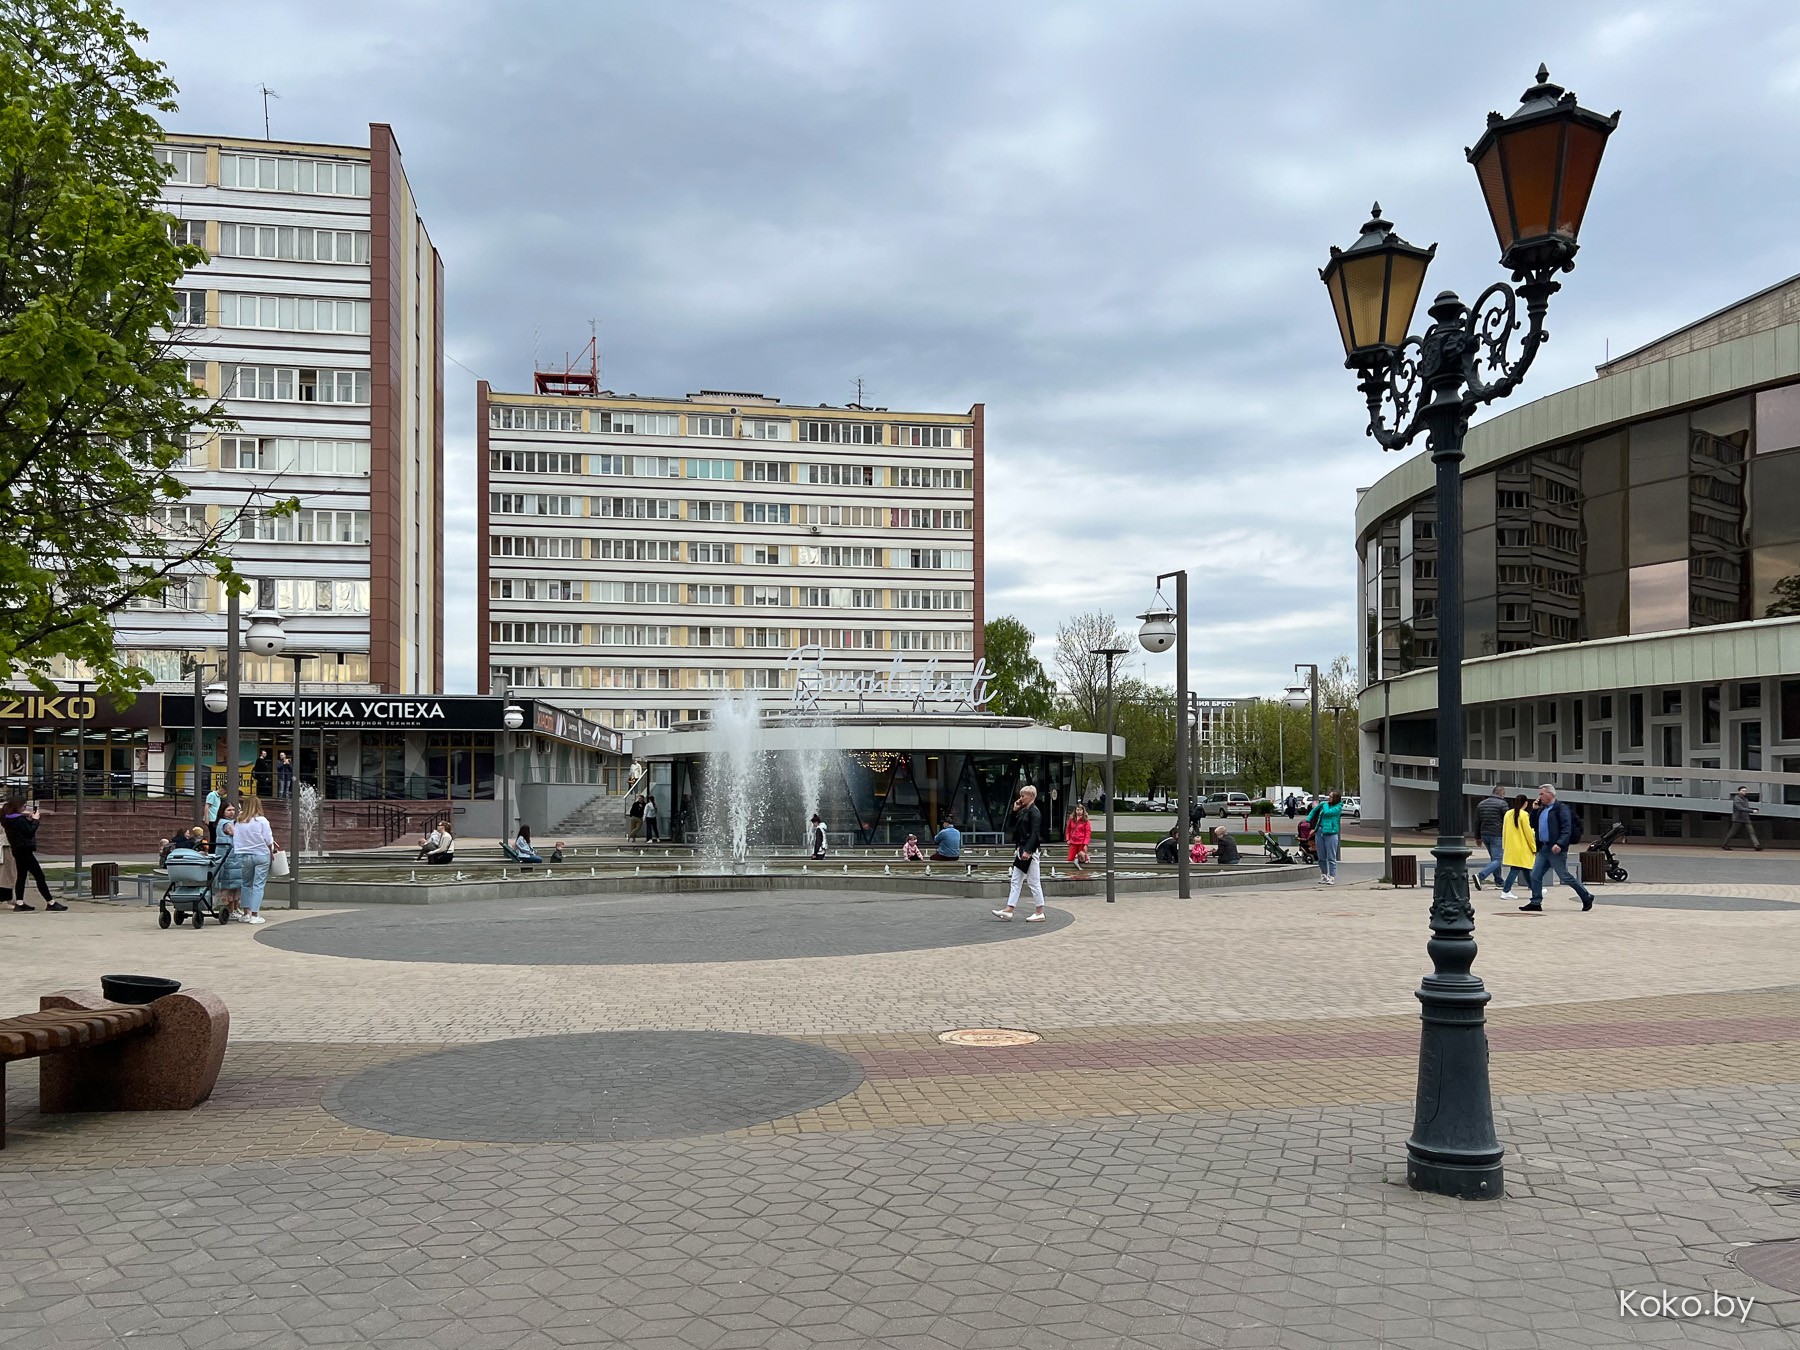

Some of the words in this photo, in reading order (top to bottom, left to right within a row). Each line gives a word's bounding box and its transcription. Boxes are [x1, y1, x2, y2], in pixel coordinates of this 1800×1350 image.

[785, 644, 998, 706] Buontalenti
[0, 696, 96, 719] ZIKO
[253, 700, 354, 718] ТЕХНИКА
[360, 702, 445, 719] УСПЕХА
